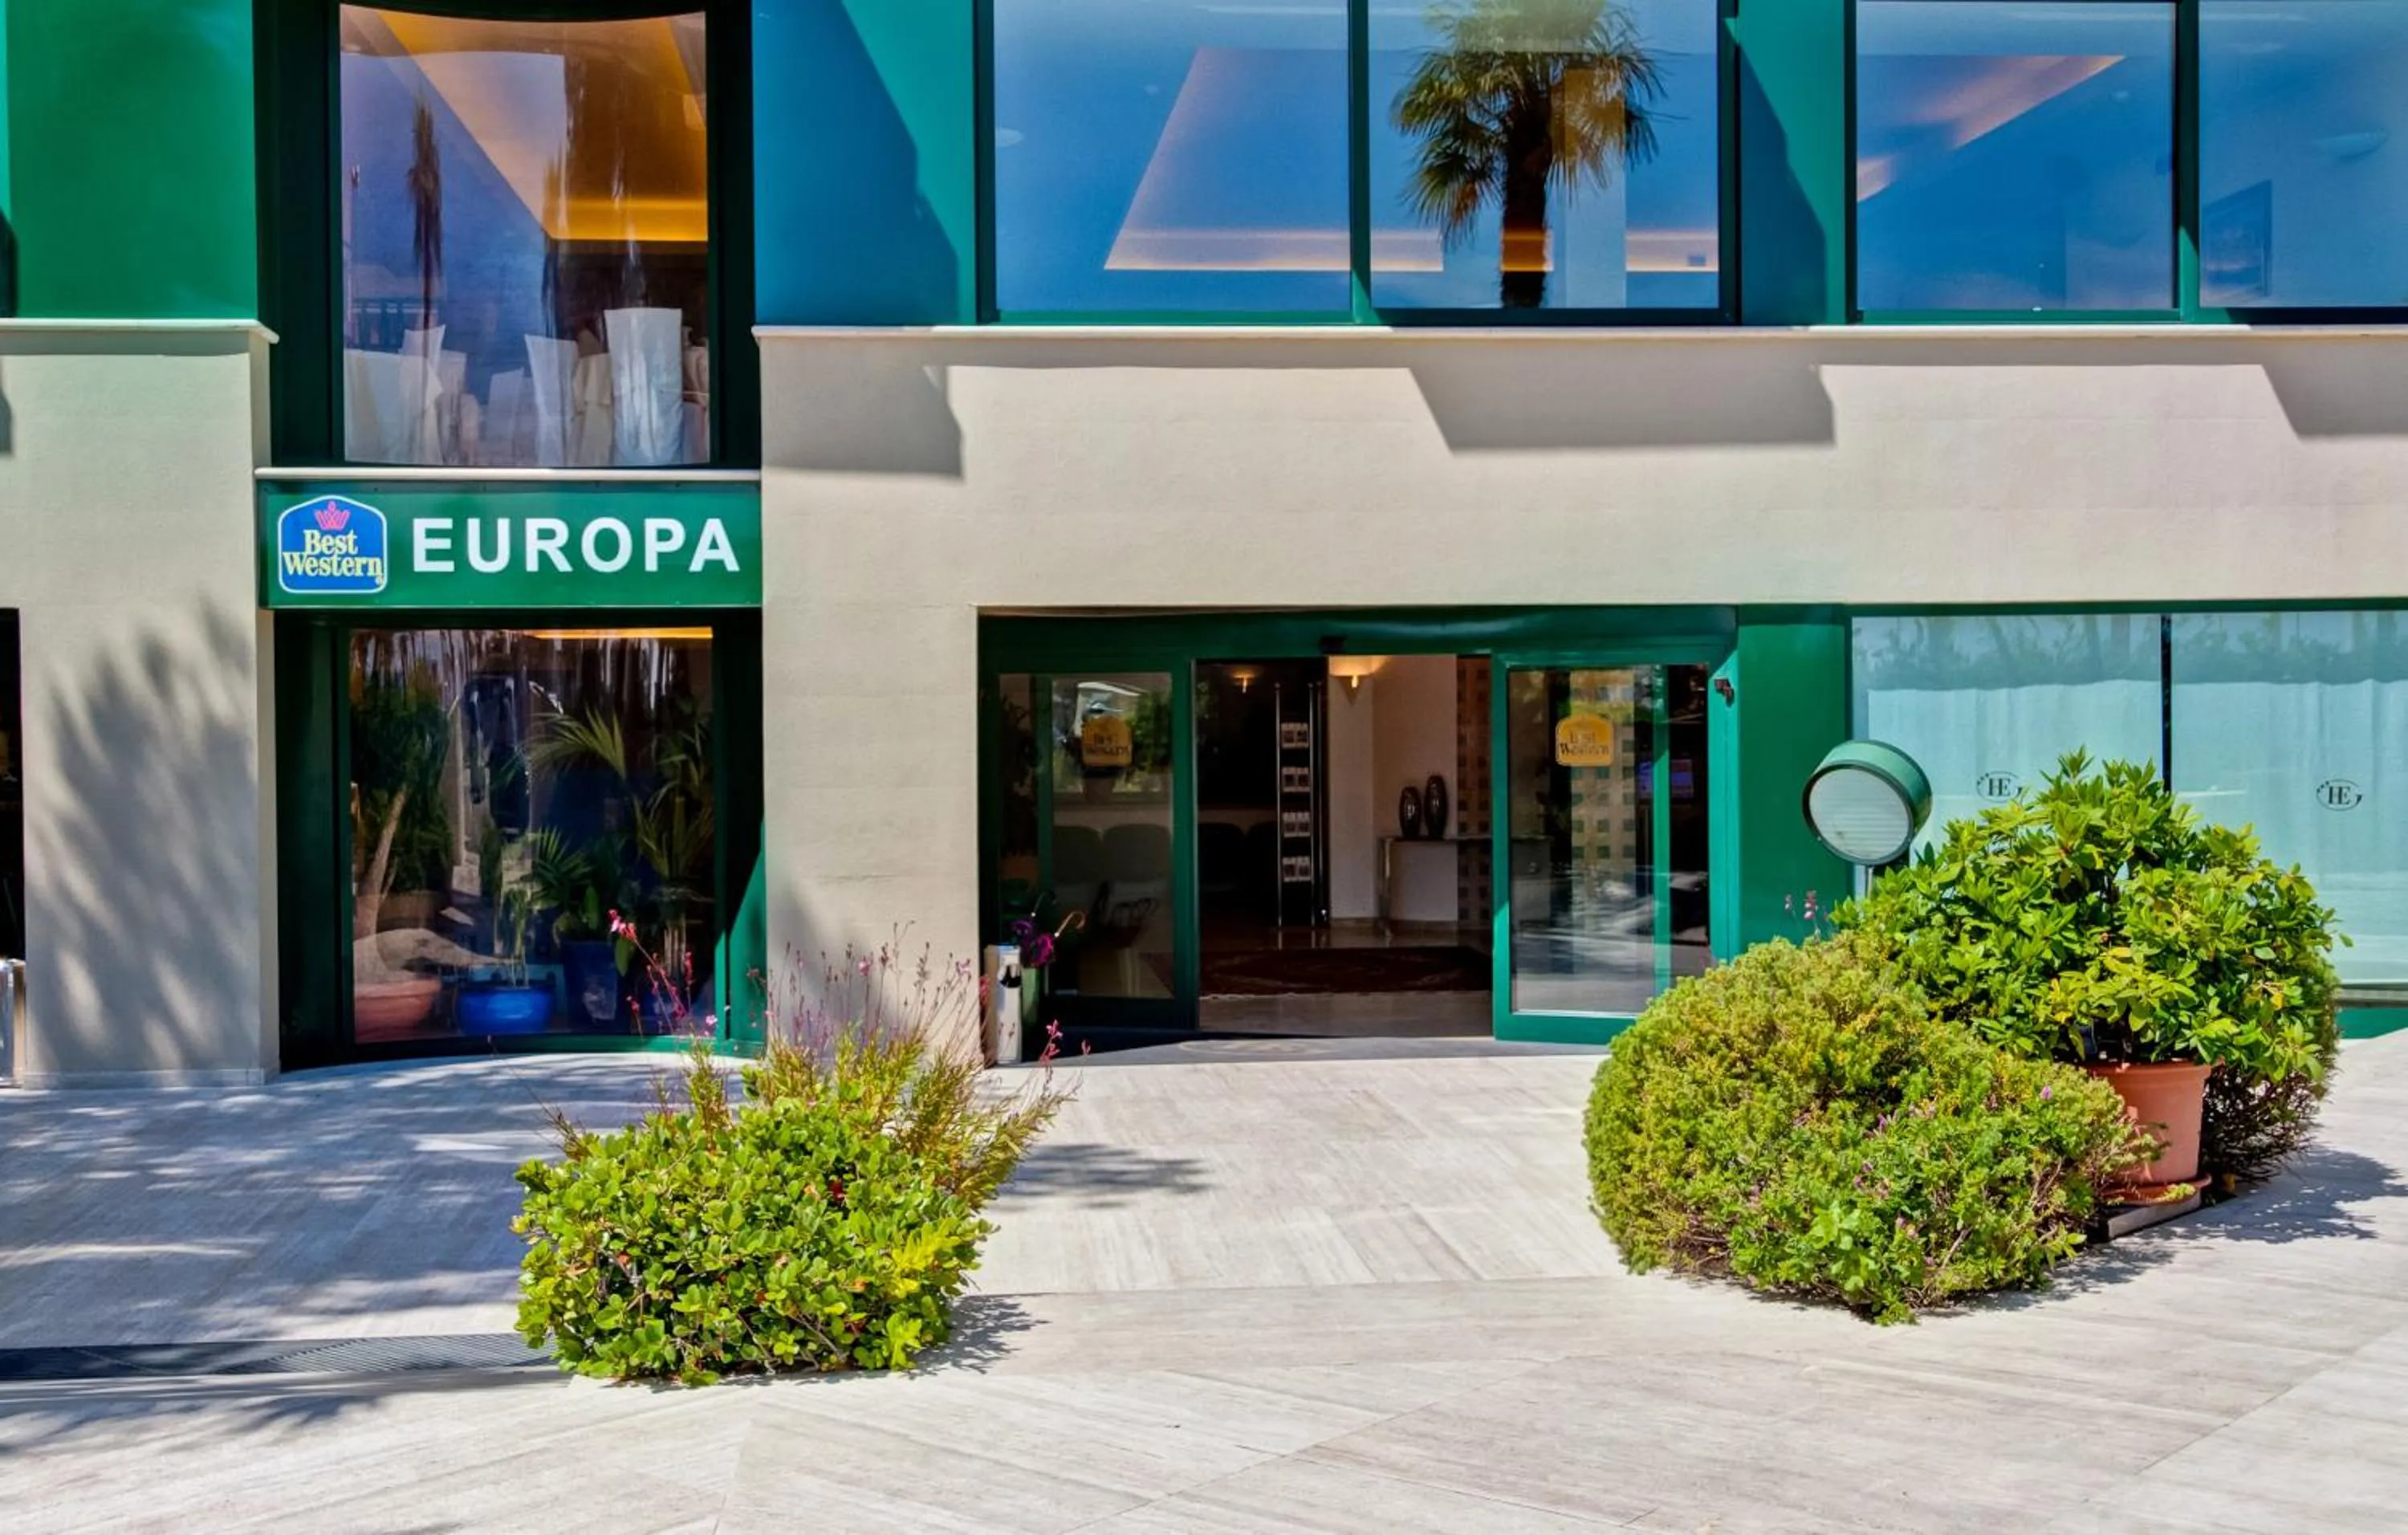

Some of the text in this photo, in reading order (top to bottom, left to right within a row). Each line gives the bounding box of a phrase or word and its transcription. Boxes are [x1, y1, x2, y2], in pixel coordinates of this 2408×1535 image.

[303, 528, 359, 555] Best
[412, 517, 740, 572] EUROPA
[283, 552, 383, 577] Western
